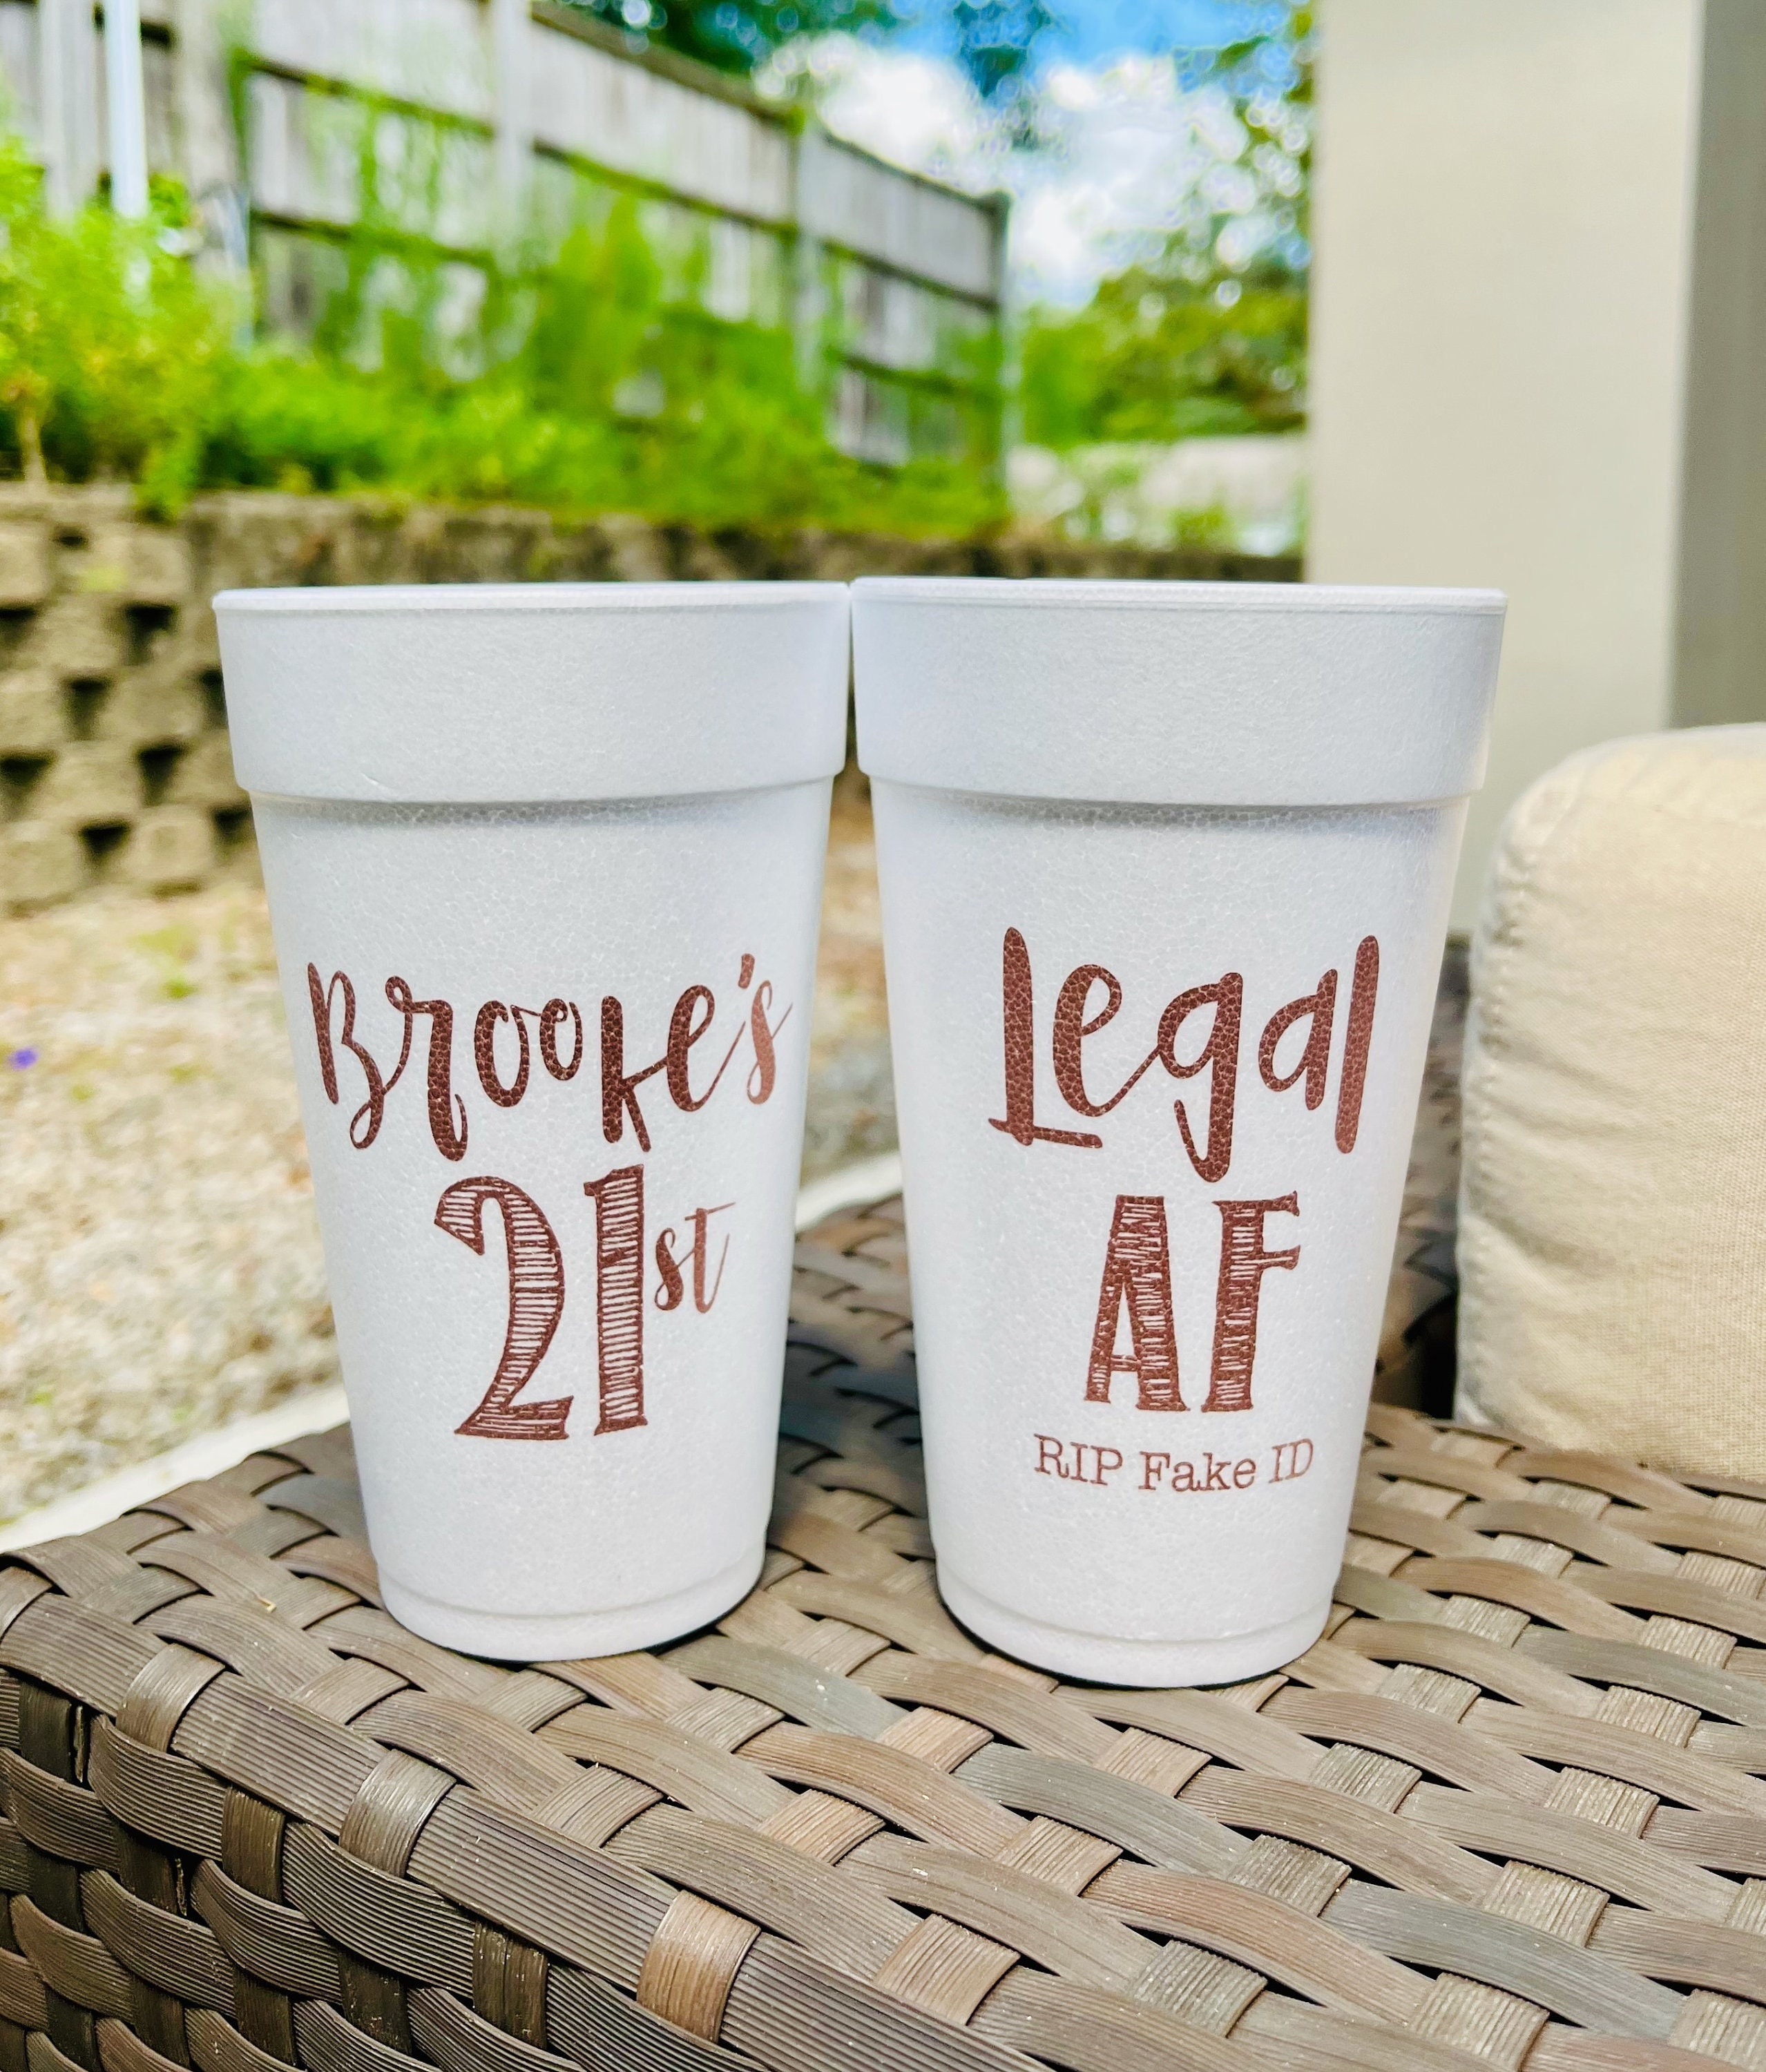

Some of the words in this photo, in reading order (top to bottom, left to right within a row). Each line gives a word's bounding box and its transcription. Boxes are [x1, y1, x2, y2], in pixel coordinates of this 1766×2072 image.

[307, 953, 794, 1162] Brooke's
[988, 926, 1380, 1183] Legal
[434, 1163, 736, 1441] 21st
[1084, 1190, 1302, 1413] AF
[1033, 1434, 1123, 1486] RIP
[1138, 1450, 1257, 1492] Fake
[1269, 1437, 1314, 1483] ID
